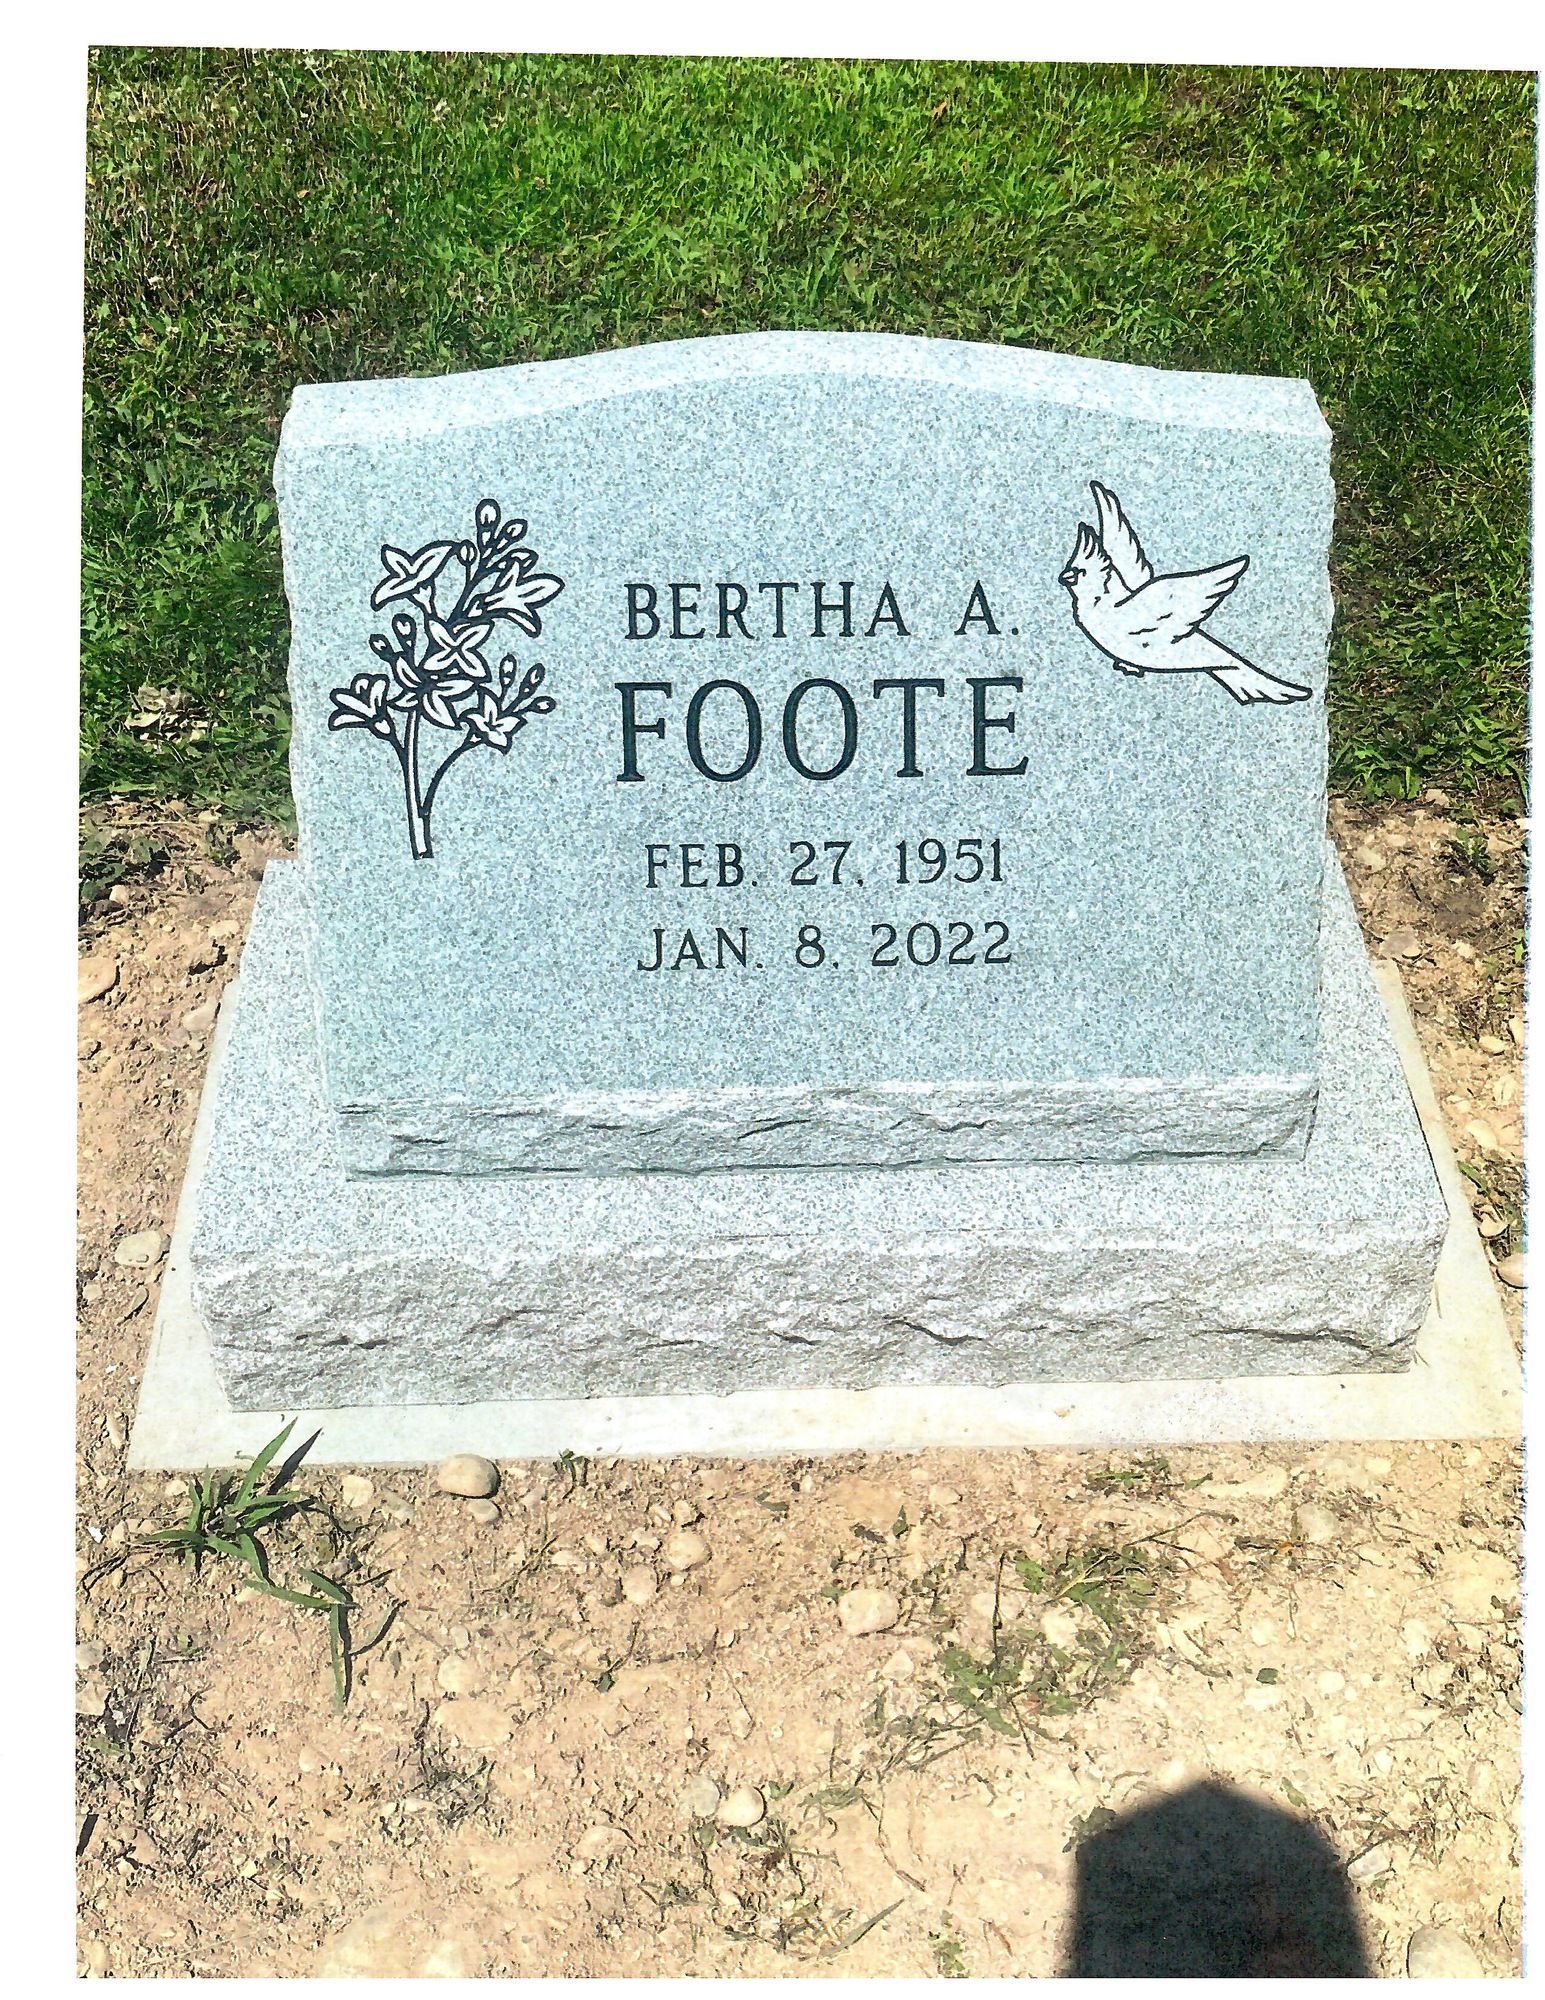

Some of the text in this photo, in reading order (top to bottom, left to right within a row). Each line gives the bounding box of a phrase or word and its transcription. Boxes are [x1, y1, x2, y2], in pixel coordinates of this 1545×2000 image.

[624, 579, 1020, 640] BERTHA A.
[614, 676, 1029, 782] FOOTE
[644, 843, 759, 889] FEB.
[895, 838, 1004, 884] 1951
[637, 927, 765, 972] JAN.
[871, 920, 1013, 967] 2022
